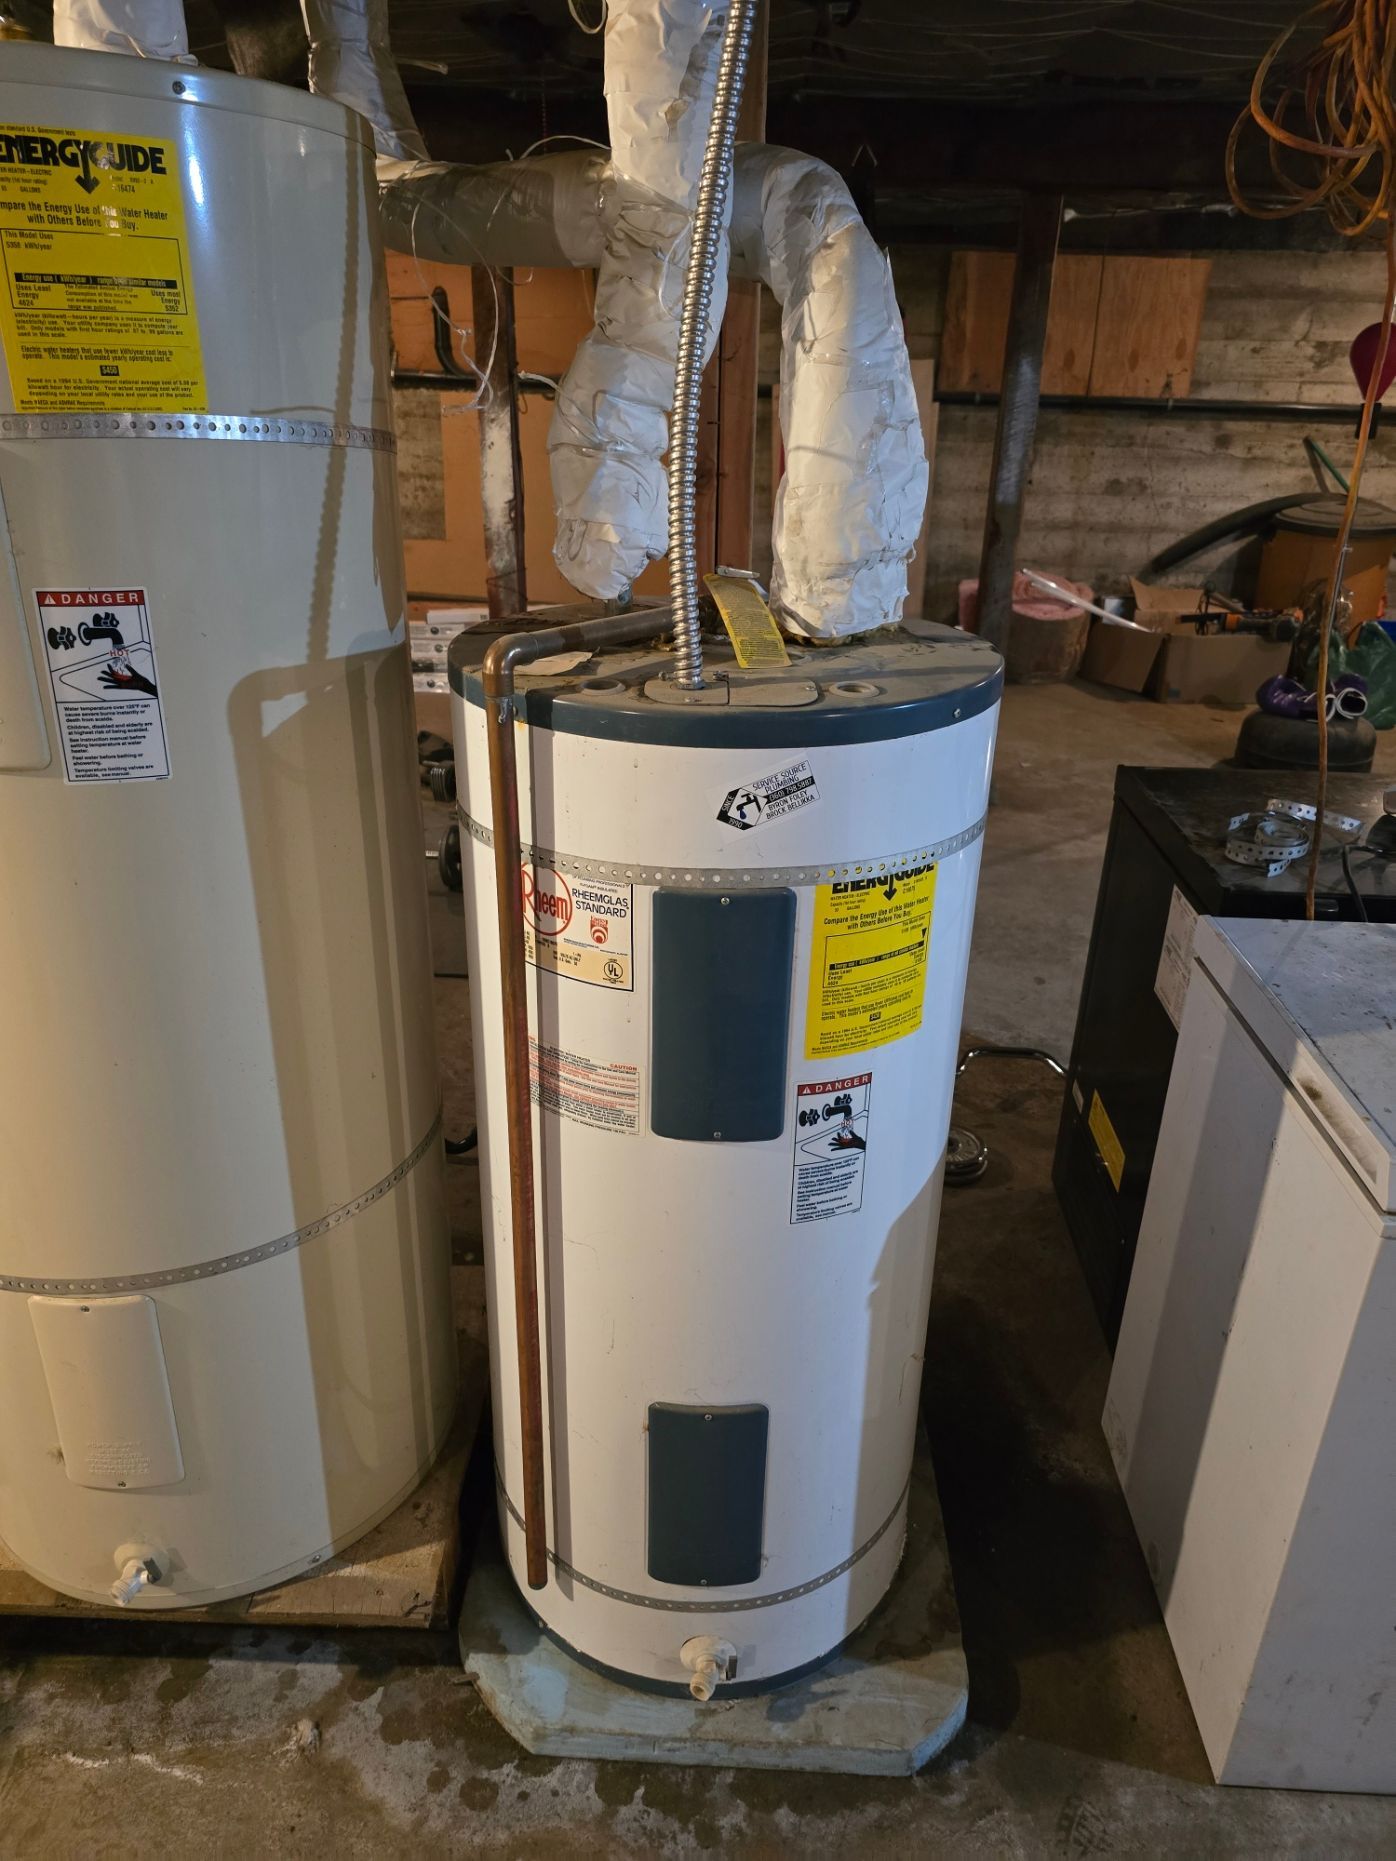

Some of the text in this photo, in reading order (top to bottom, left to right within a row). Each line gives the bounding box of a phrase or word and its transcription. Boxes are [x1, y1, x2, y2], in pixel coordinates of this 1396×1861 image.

[29, 201, 42, 211] the
[44, 202, 72, 215] Energy
[75, 204, 90, 214] Use
[119, 207, 142, 218] Water
[144, 208, 168, 220] Heater
[27, 214, 45, 224] with
[47, 214, 74, 225] Others
[76, 216, 101, 227] Before
[61, 593, 139, 605] DANGER
[109, 649, 129, 658] HOT
[752, 763, 807, 791] SERVICE SOURCE
[764, 774, 800, 795] PLUMBING
[721, 795, 734, 812] SINCE
[768, 789, 808, 812] BYRON FOLEY
[766, 806, 787, 820] BROCK
[521, 868, 569, 922] Rheem
[575, 900, 627, 918] STANDARD
[823, 916, 848, 926] Compare
[860, 911, 877, 922] Energy
[860, 918, 876, 929] Others
[607, 963, 619, 978] UL
[610, 1063, 637, 1072] CAUTION
[815, 1074, 870, 1092] DANGER
